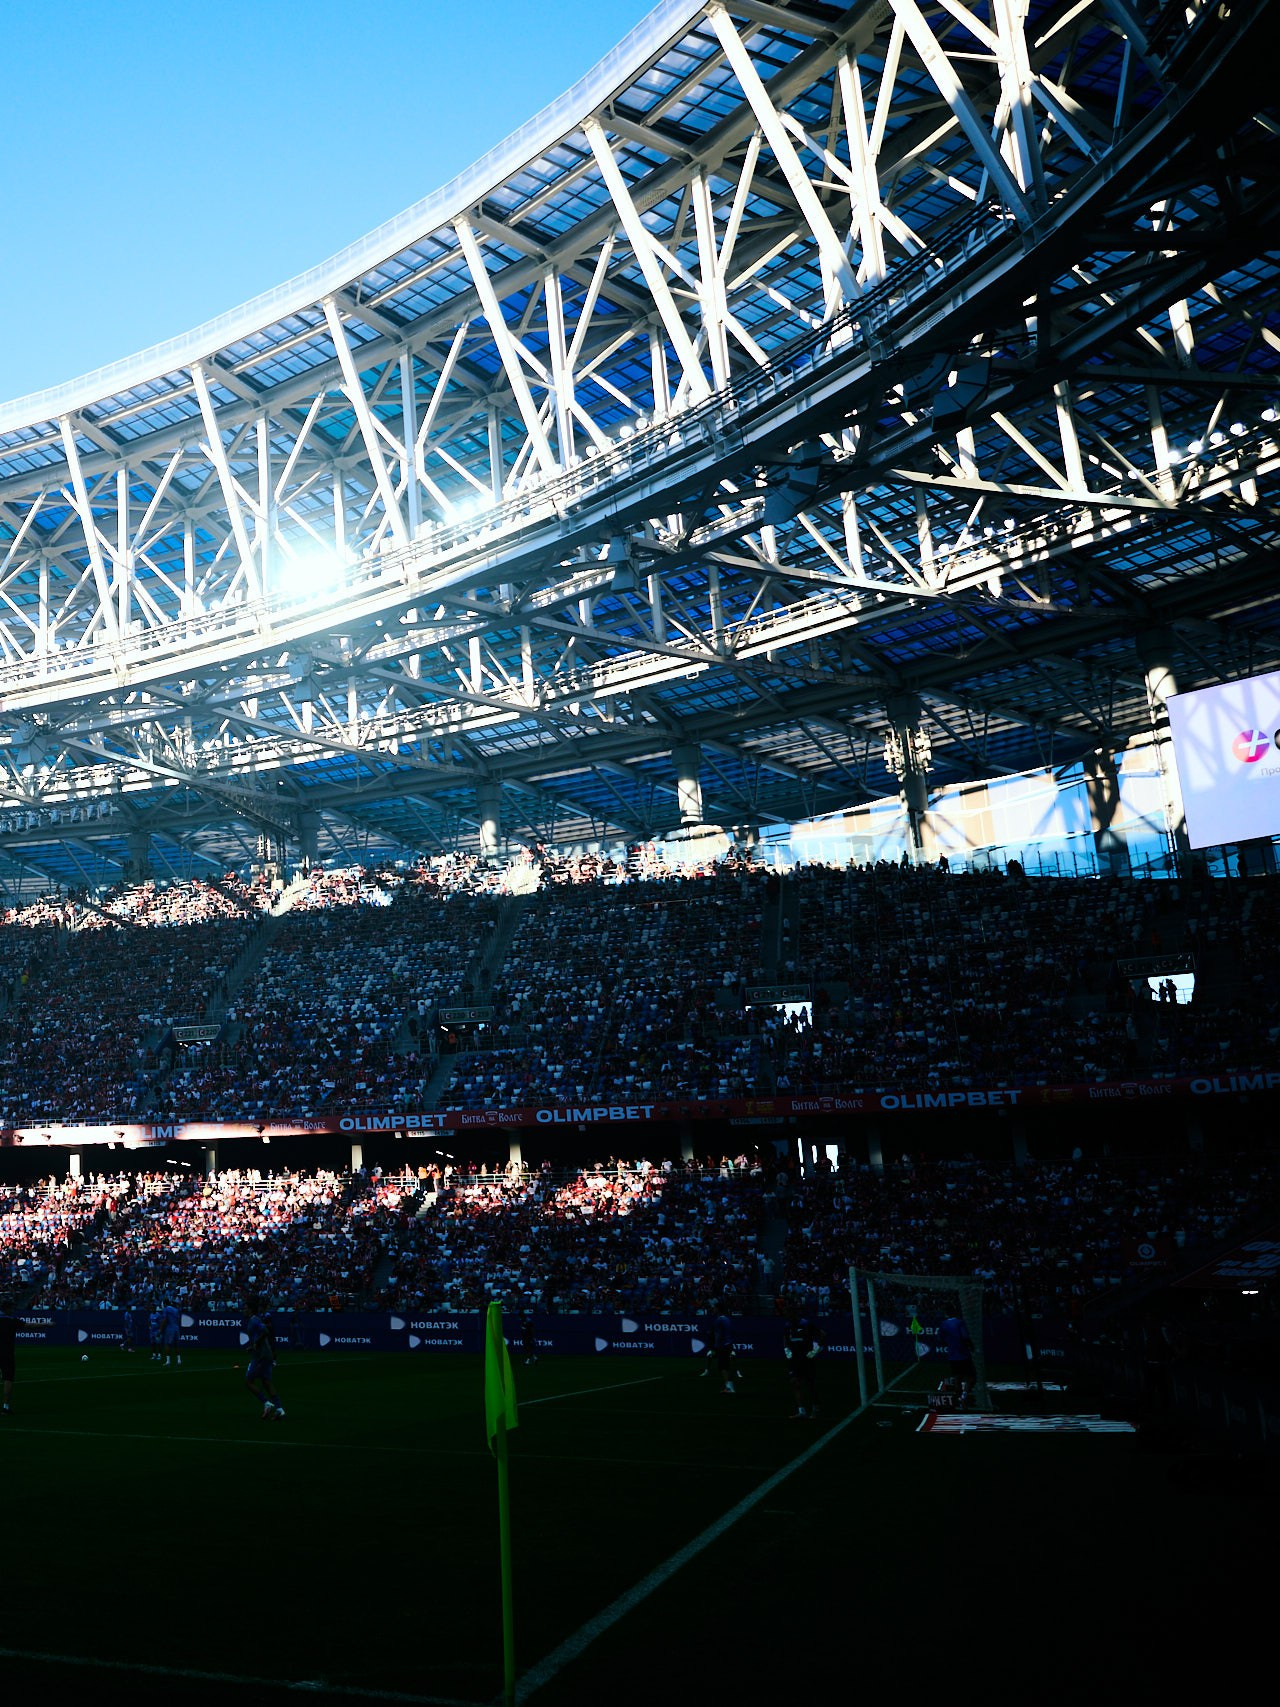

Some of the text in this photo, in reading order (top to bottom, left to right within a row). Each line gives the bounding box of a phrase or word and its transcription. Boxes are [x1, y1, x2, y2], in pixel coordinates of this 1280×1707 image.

[880, 1090, 1022, 1109] OLIMPBET
[535, 1105, 655, 1123] OLIMPBET
[339, 1114, 448, 1131] OLIMPBET
[199, 1319, 242, 1327] НОВАТЭК
[410, 1321, 459, 1329] НОВАТЭК
[644, 1323, 699, 1332] НОВАТЭК
[424, 1338, 463, 1346] НОВАТЭК
[612, 1341, 655, 1349] НОВАТЭК
